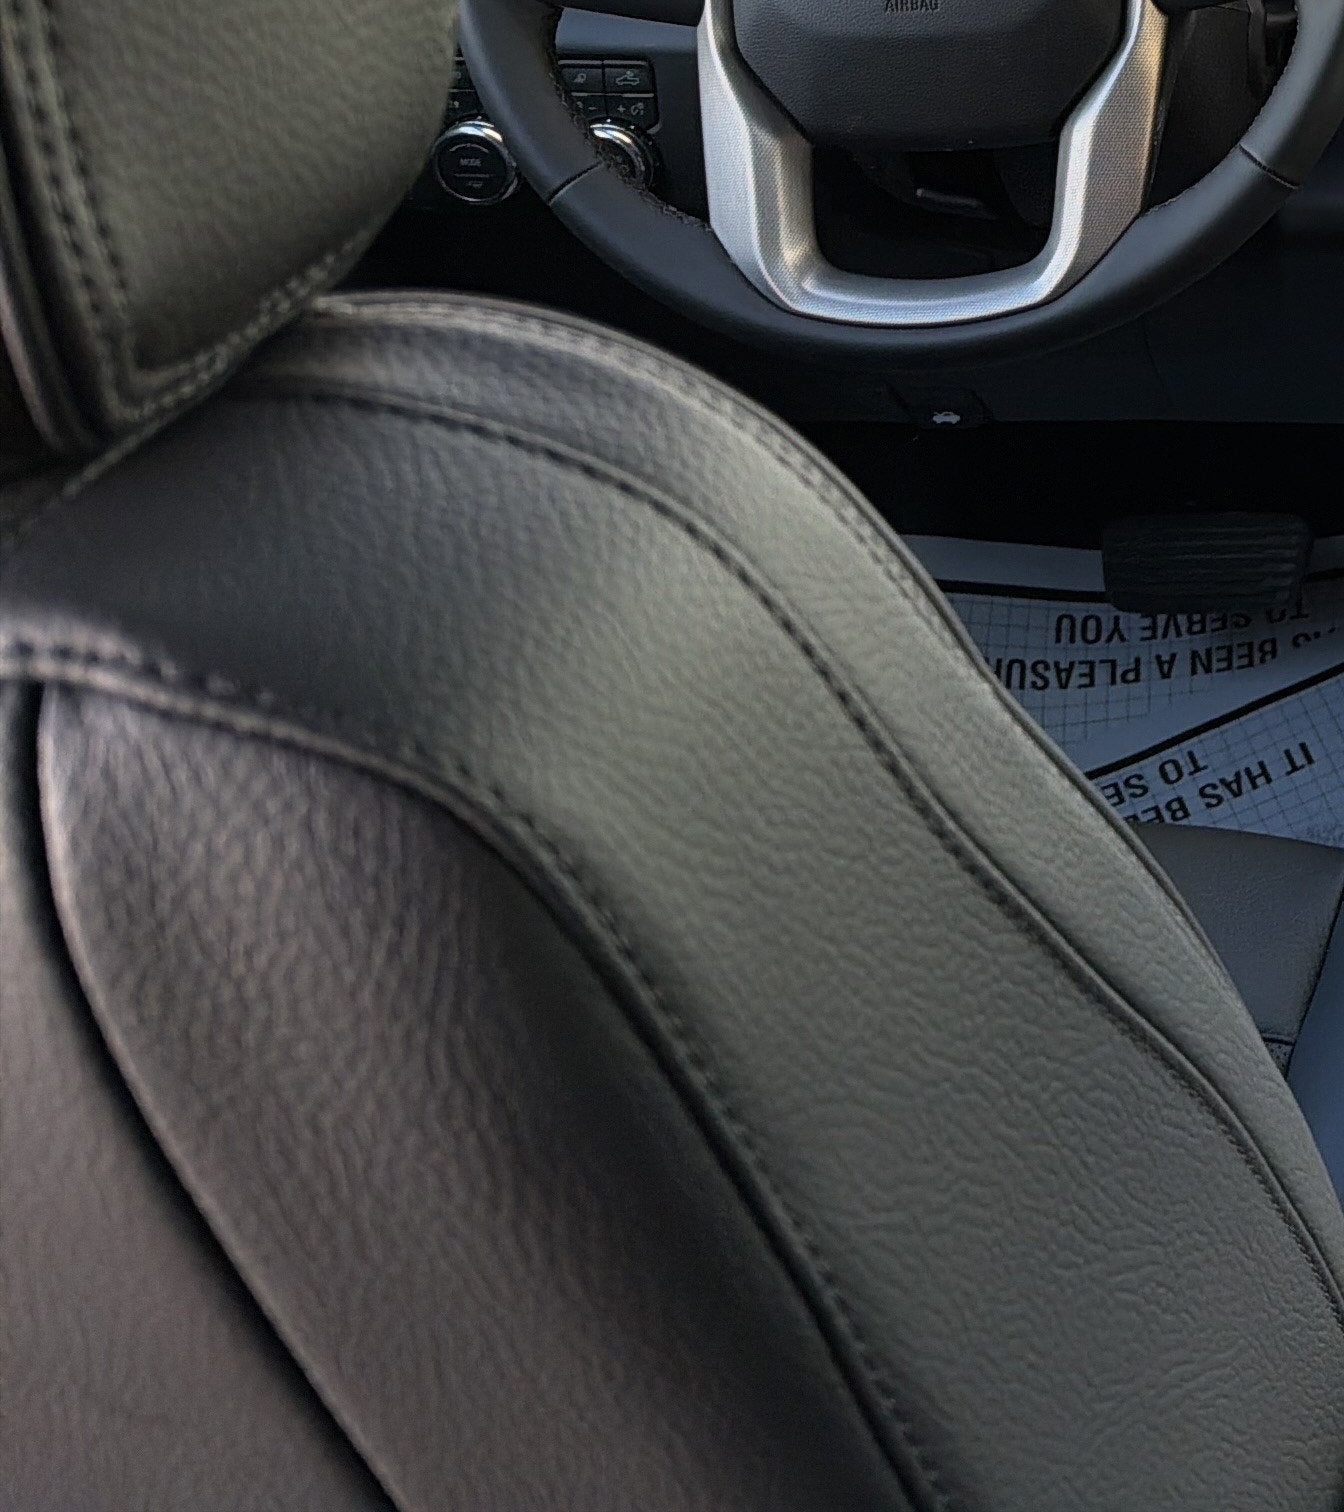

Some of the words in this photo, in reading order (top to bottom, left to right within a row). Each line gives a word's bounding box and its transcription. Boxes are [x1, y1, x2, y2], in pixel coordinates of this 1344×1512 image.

[1055, 613, 1128, 645] YOU
[1155, 652, 1178, 681] A
[1189, 637, 1278, 675] BEEN
[1158, 749, 1209, 786] TO
[1284, 742, 1316, 777] IT
[1198, 760, 1274, 810] HAS
